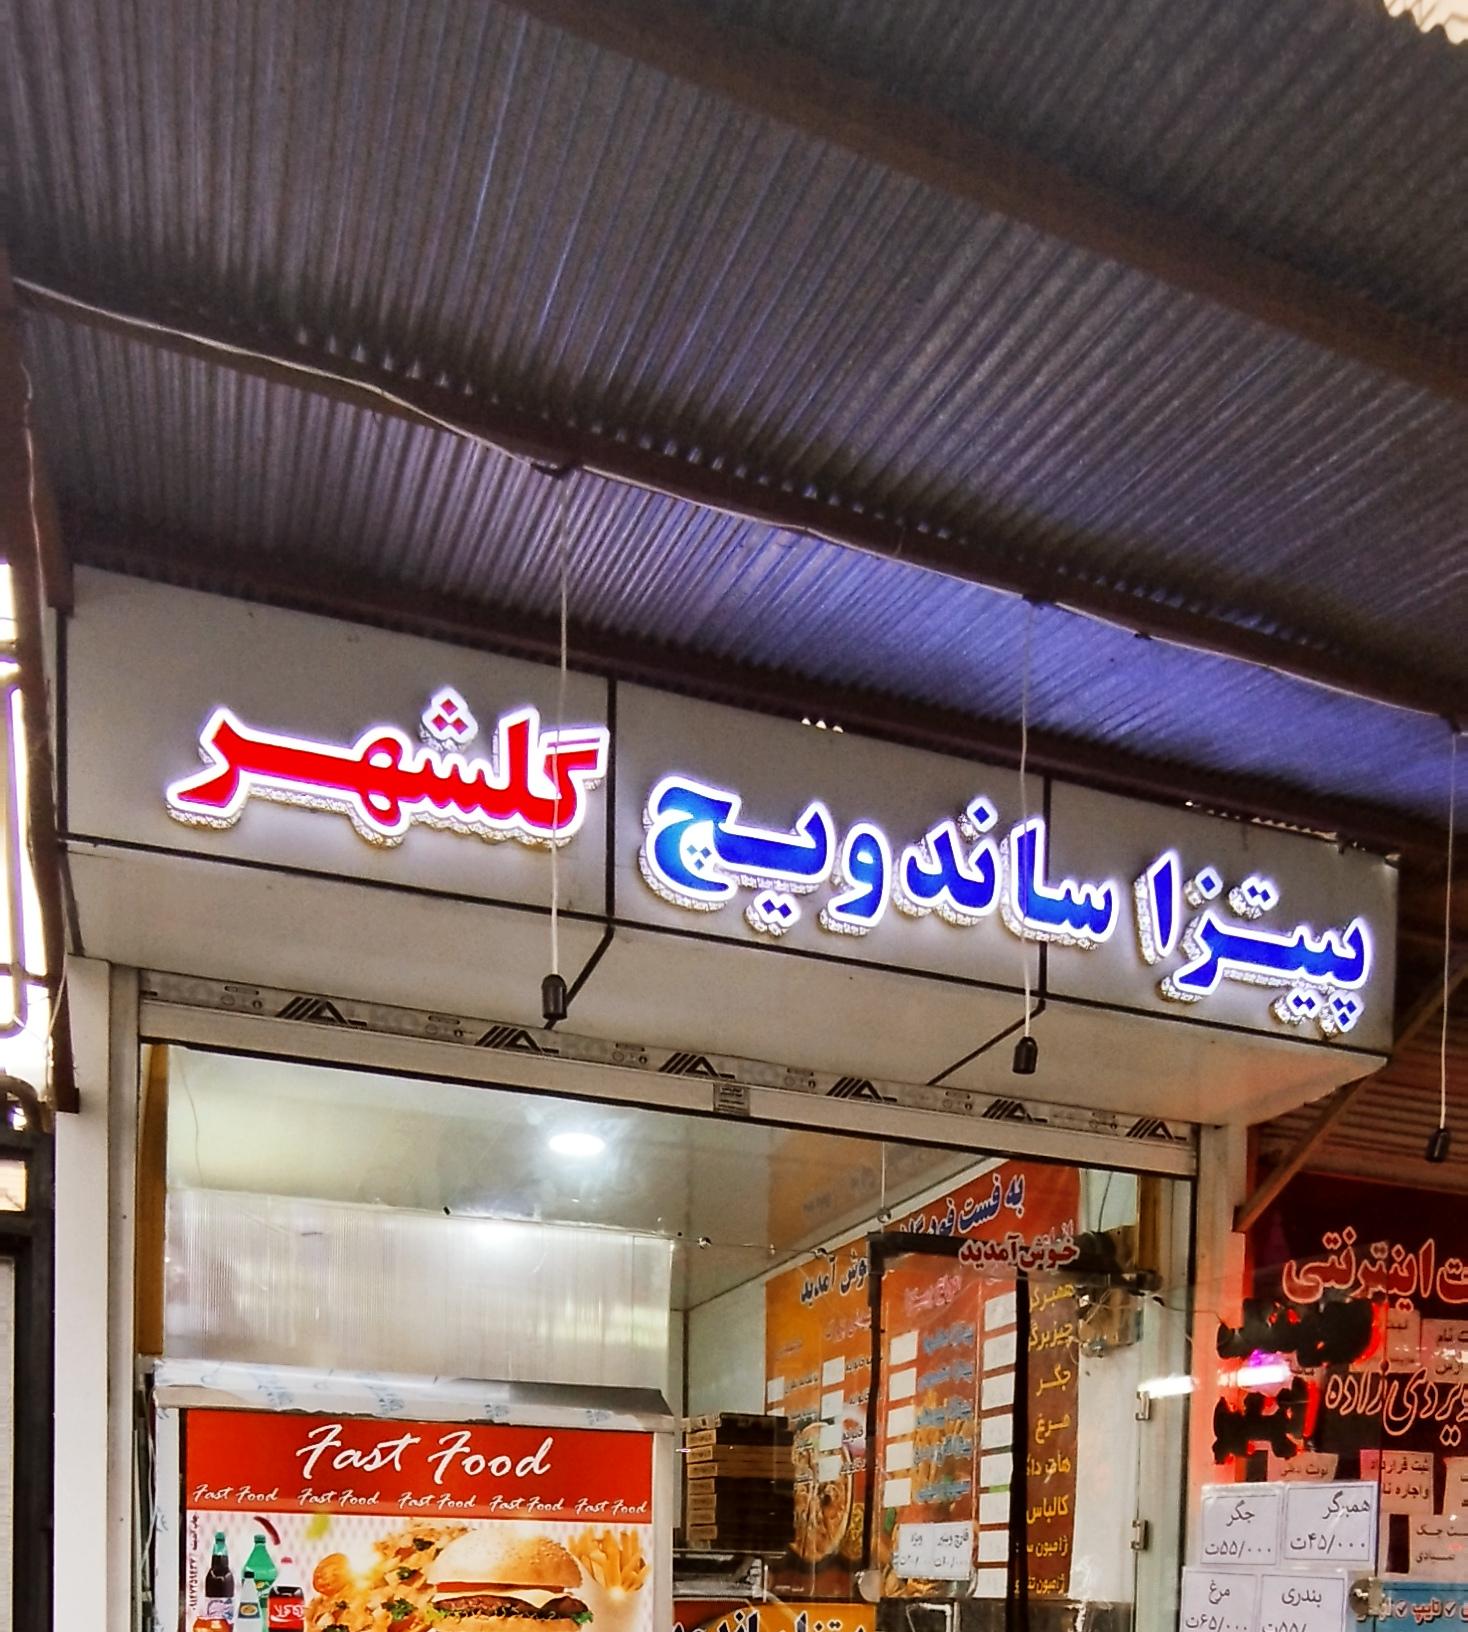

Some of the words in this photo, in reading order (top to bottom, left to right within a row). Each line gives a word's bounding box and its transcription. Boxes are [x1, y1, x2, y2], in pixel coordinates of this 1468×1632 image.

[166, 688, 608, 848] گلشهر
[640, 776, 1117, 948] ساندویچ
[1136, 850, 1372, 1036] پیتزا
[295, 1423, 421, 1480] Fast
[427, 1430, 554, 1485] Food
[193, 1484, 234, 1502] Fast
[235, 1486, 279, 1503] Food
[297, 1488, 336, 1507] Fast
[338, 1489, 380, 1508] Food
[398, 1491, 435, 1510] Fast
[436, 1493, 477, 1511] Food
[489, 1495, 525, 1514] Fast
[526, 1496, 564, 1514] Food
[575, 1498, 608, 1516] Fast
[611, 1499, 647, 1516] Food
[1226, 1500, 1256, 1527] جگر
[1208, 1579, 1231, 1605] مرغ
[1281, 1588, 1322, 1609] بندری
